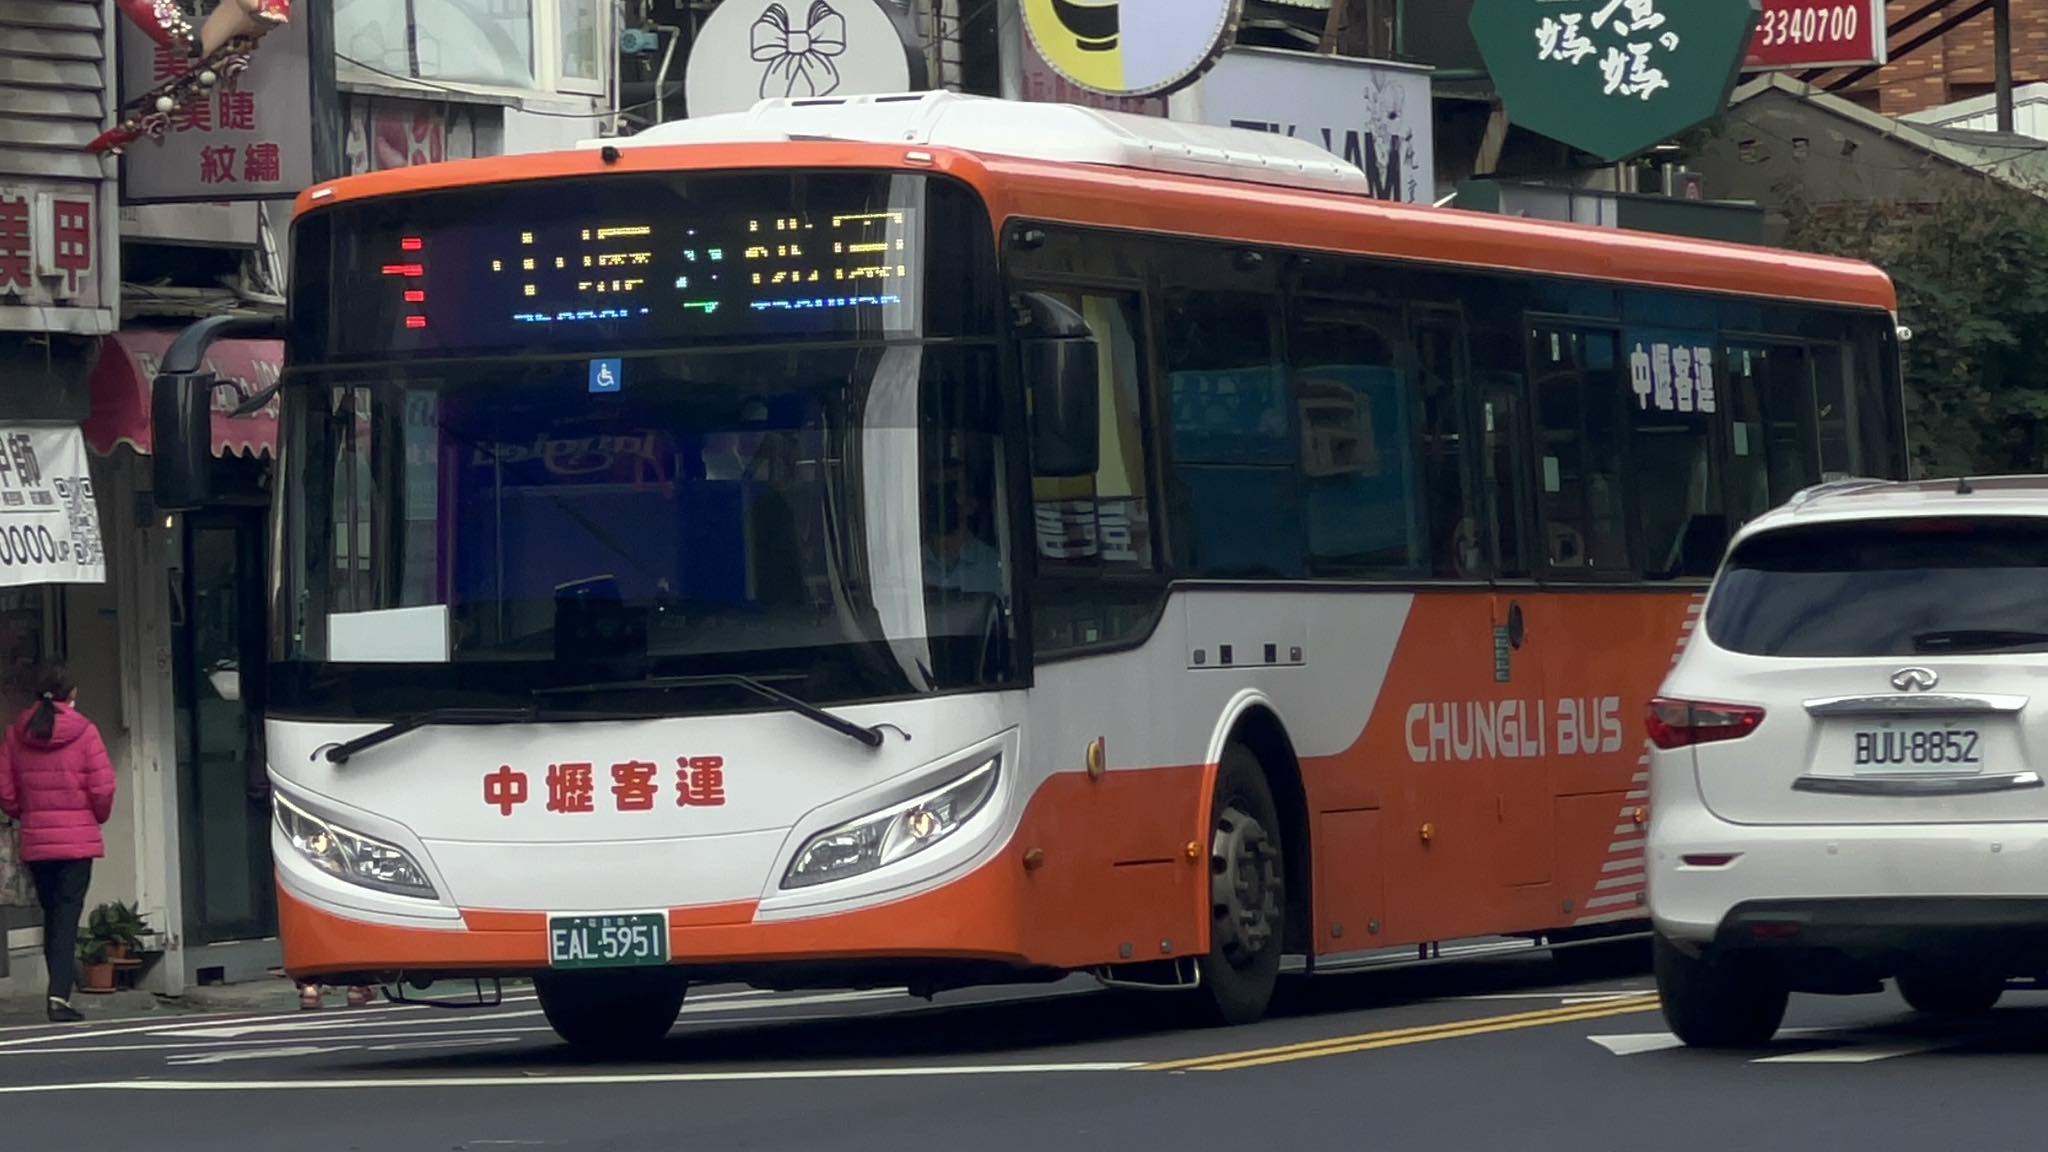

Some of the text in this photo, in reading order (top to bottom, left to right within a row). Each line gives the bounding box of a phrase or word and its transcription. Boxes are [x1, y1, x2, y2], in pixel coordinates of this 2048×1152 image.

[1631, 343, 1716, 413] 中壢客運
[1405, 696, 1622, 762] CHUNGLI BUS
[1855, 730, 1979, 765] BUU-8852
[484, 756, 725, 816] 中壢客運
[552, 925, 660, 960] EAL-5951
